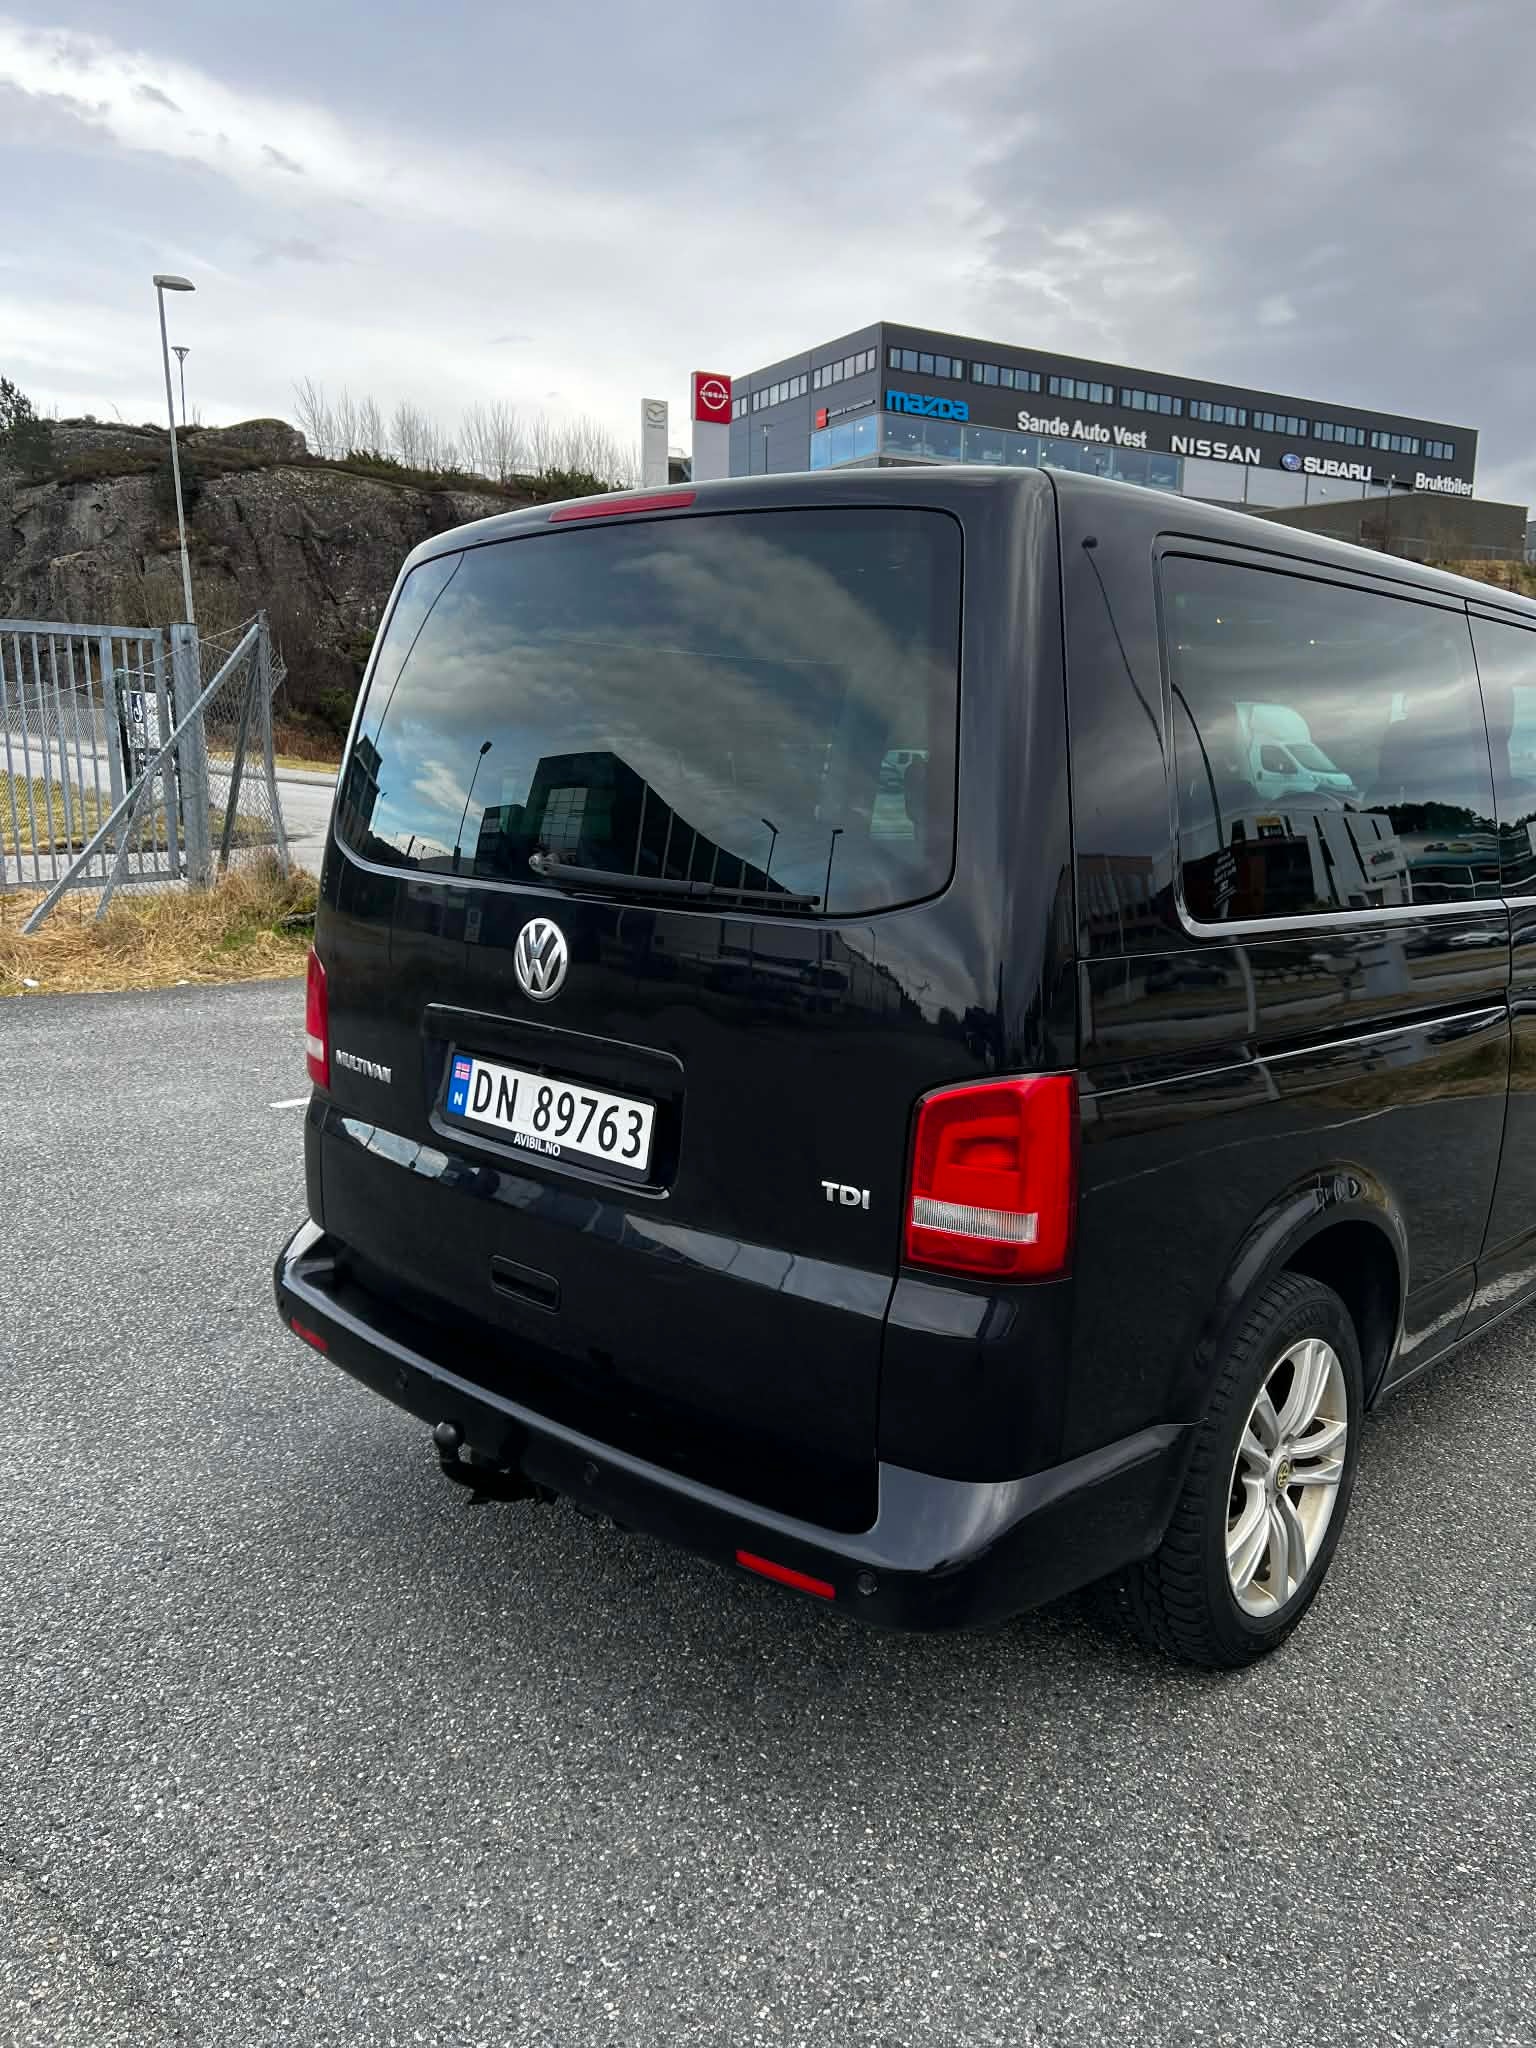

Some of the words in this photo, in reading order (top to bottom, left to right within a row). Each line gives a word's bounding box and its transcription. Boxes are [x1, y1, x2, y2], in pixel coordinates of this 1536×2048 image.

[1017, 410, 1070, 437] Sande
[1071, 419, 1111, 443] Auto
[1113, 425, 1148, 449] Vest
[1170, 434, 1261, 465] NISSAN
[1303, 456, 1372, 482] SUBARU
[1415, 472, 1473, 496] Bruktbiler
[335, 1049, 392, 1084] MULTIVAN
[453, 1094, 463, 1106] N
[472, 1068, 520, 1123] DN
[532, 1084, 645, 1159] 89763
[821, 1180, 871, 1210] TDI
